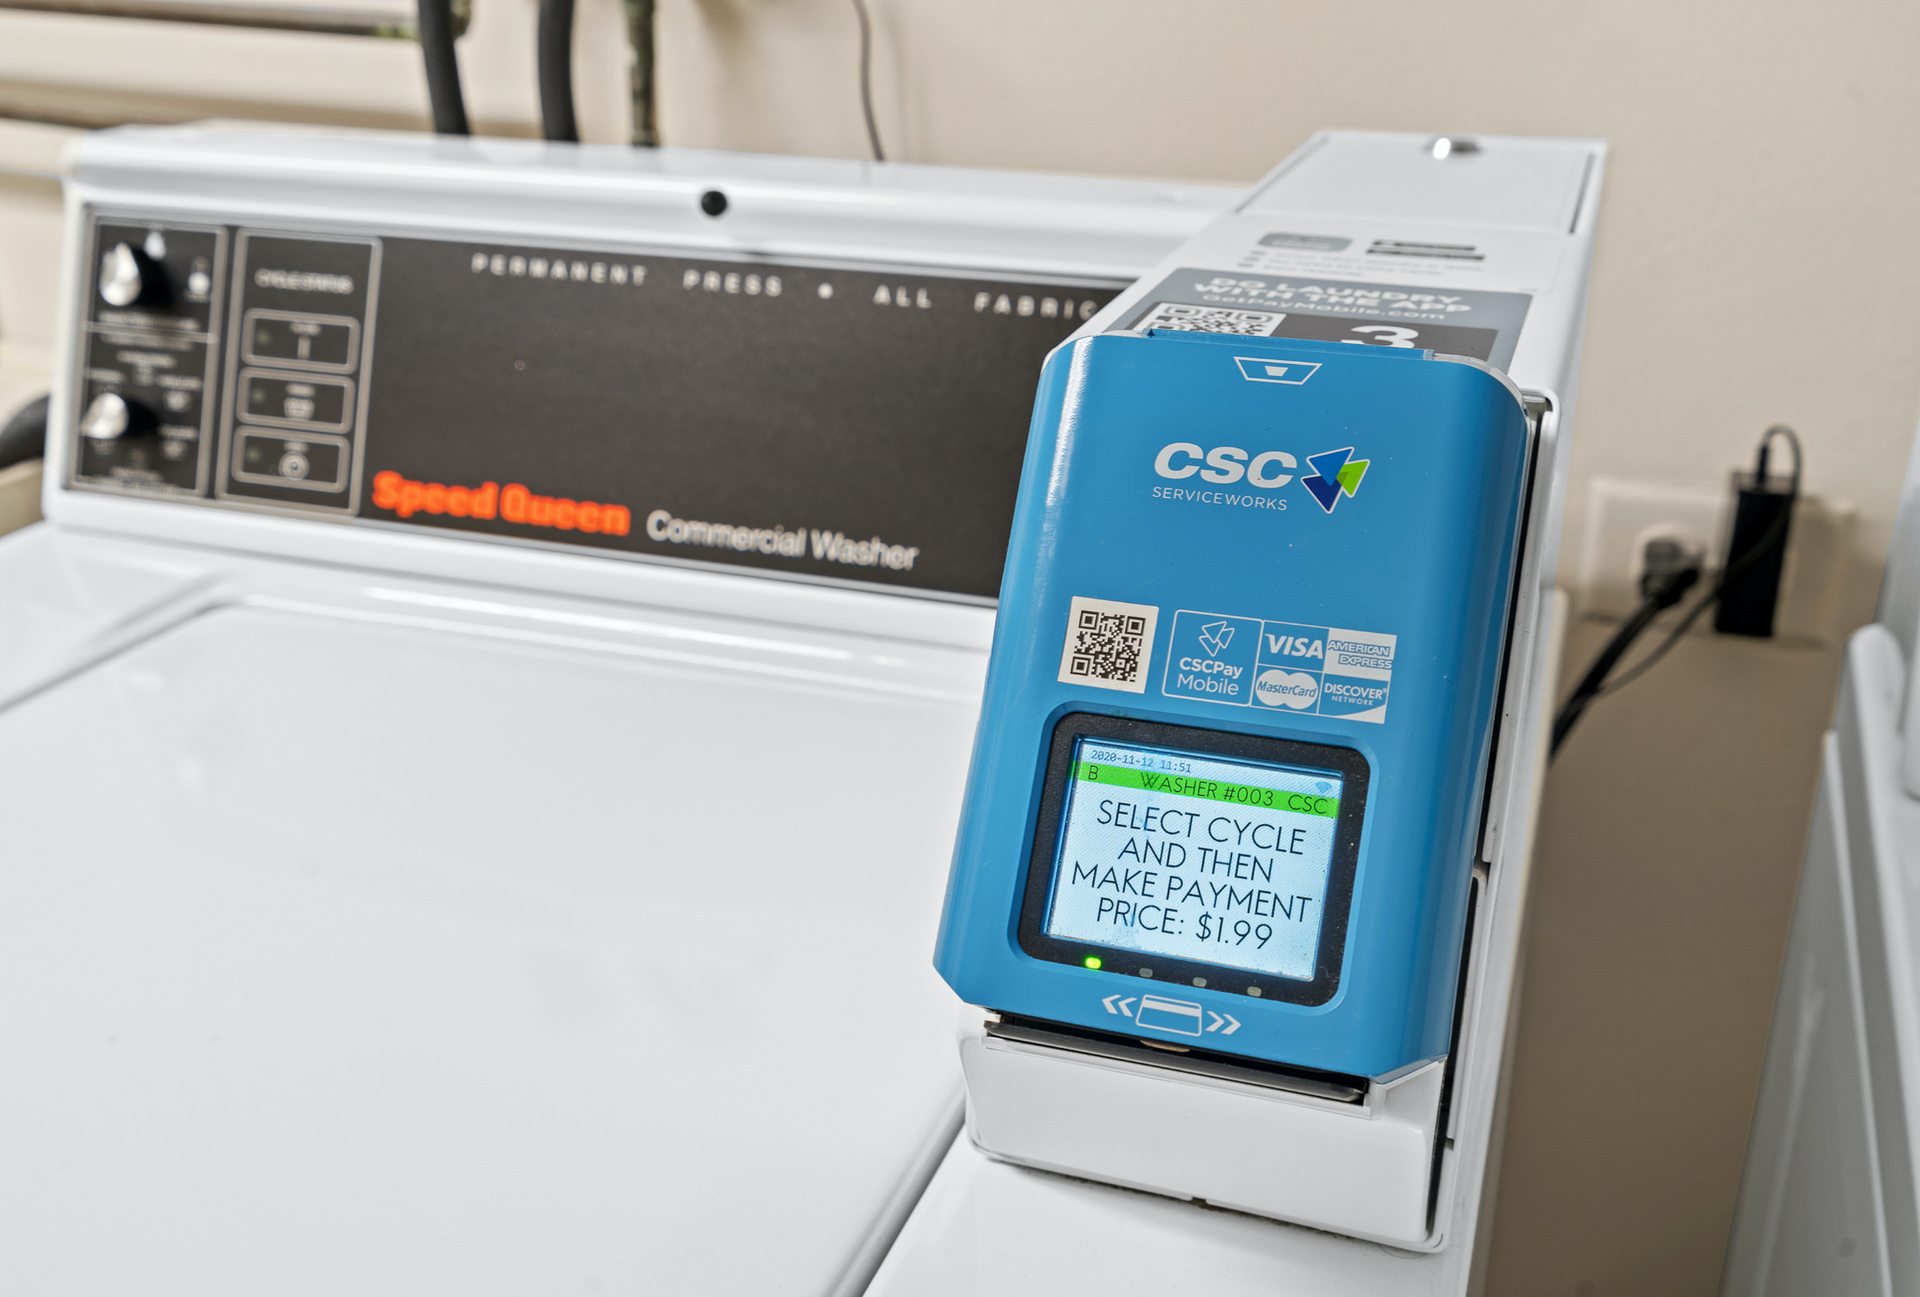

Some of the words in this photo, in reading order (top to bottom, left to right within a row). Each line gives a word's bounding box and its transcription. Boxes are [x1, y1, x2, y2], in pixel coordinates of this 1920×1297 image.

[471, 252, 648, 286] PERMANENT
[683, 269, 782, 297] PRESS
[873, 284, 932, 309] ALL
[1210, 278, 1266, 289] DO
[1276, 282, 1463, 303] LAUNDRY
[1194, 283, 1295, 299] WITH
[1305, 292, 1381, 307] THE
[1388, 300, 1472, 312] APP
[1340, 325, 1419, 348] 3
[1154, 442, 1297, 488] CSC
[373, 470, 499, 520] Speed
[500, 483, 631, 537] Queen
[1152, 486, 1288, 511] SERVICEWORKS
[646, 509, 806, 557] Commercial
[810, 529, 920, 570] Washer
[1264, 633, 1323, 660] VISA
[1328, 640, 1391, 657] AMERICAN
[1178, 657, 1243, 679] CSCPay
[1338, 653, 1393, 670] EXPRESS
[1177, 673, 1239, 696] Mobile
[1257, 680, 1318, 699] MasterCard
[1331, 695, 1374, 706] NETWORK
[1091, 749, 1154, 767] 2020-11-12
[1160, 760, 1192, 774] 11:51
[1087, 765, 1099, 781] B
[1140, 772, 1217, 799] WASHER
[1223, 785, 1274, 807] #003
[1288, 794, 1328, 815] CSC
[1096, 799, 1200, 838] SELECT
[1208, 816, 1307, 855] CYCLE
[1117, 837, 1187, 868] AND
[1198, 846, 1274, 883] THEN
[1072, 861, 1158, 898] MAKE
[1166, 875, 1313, 922] PAYMENT
[1096, 897, 1185, 935] PRICE:
[1195, 911, 1273, 950] $1.99
